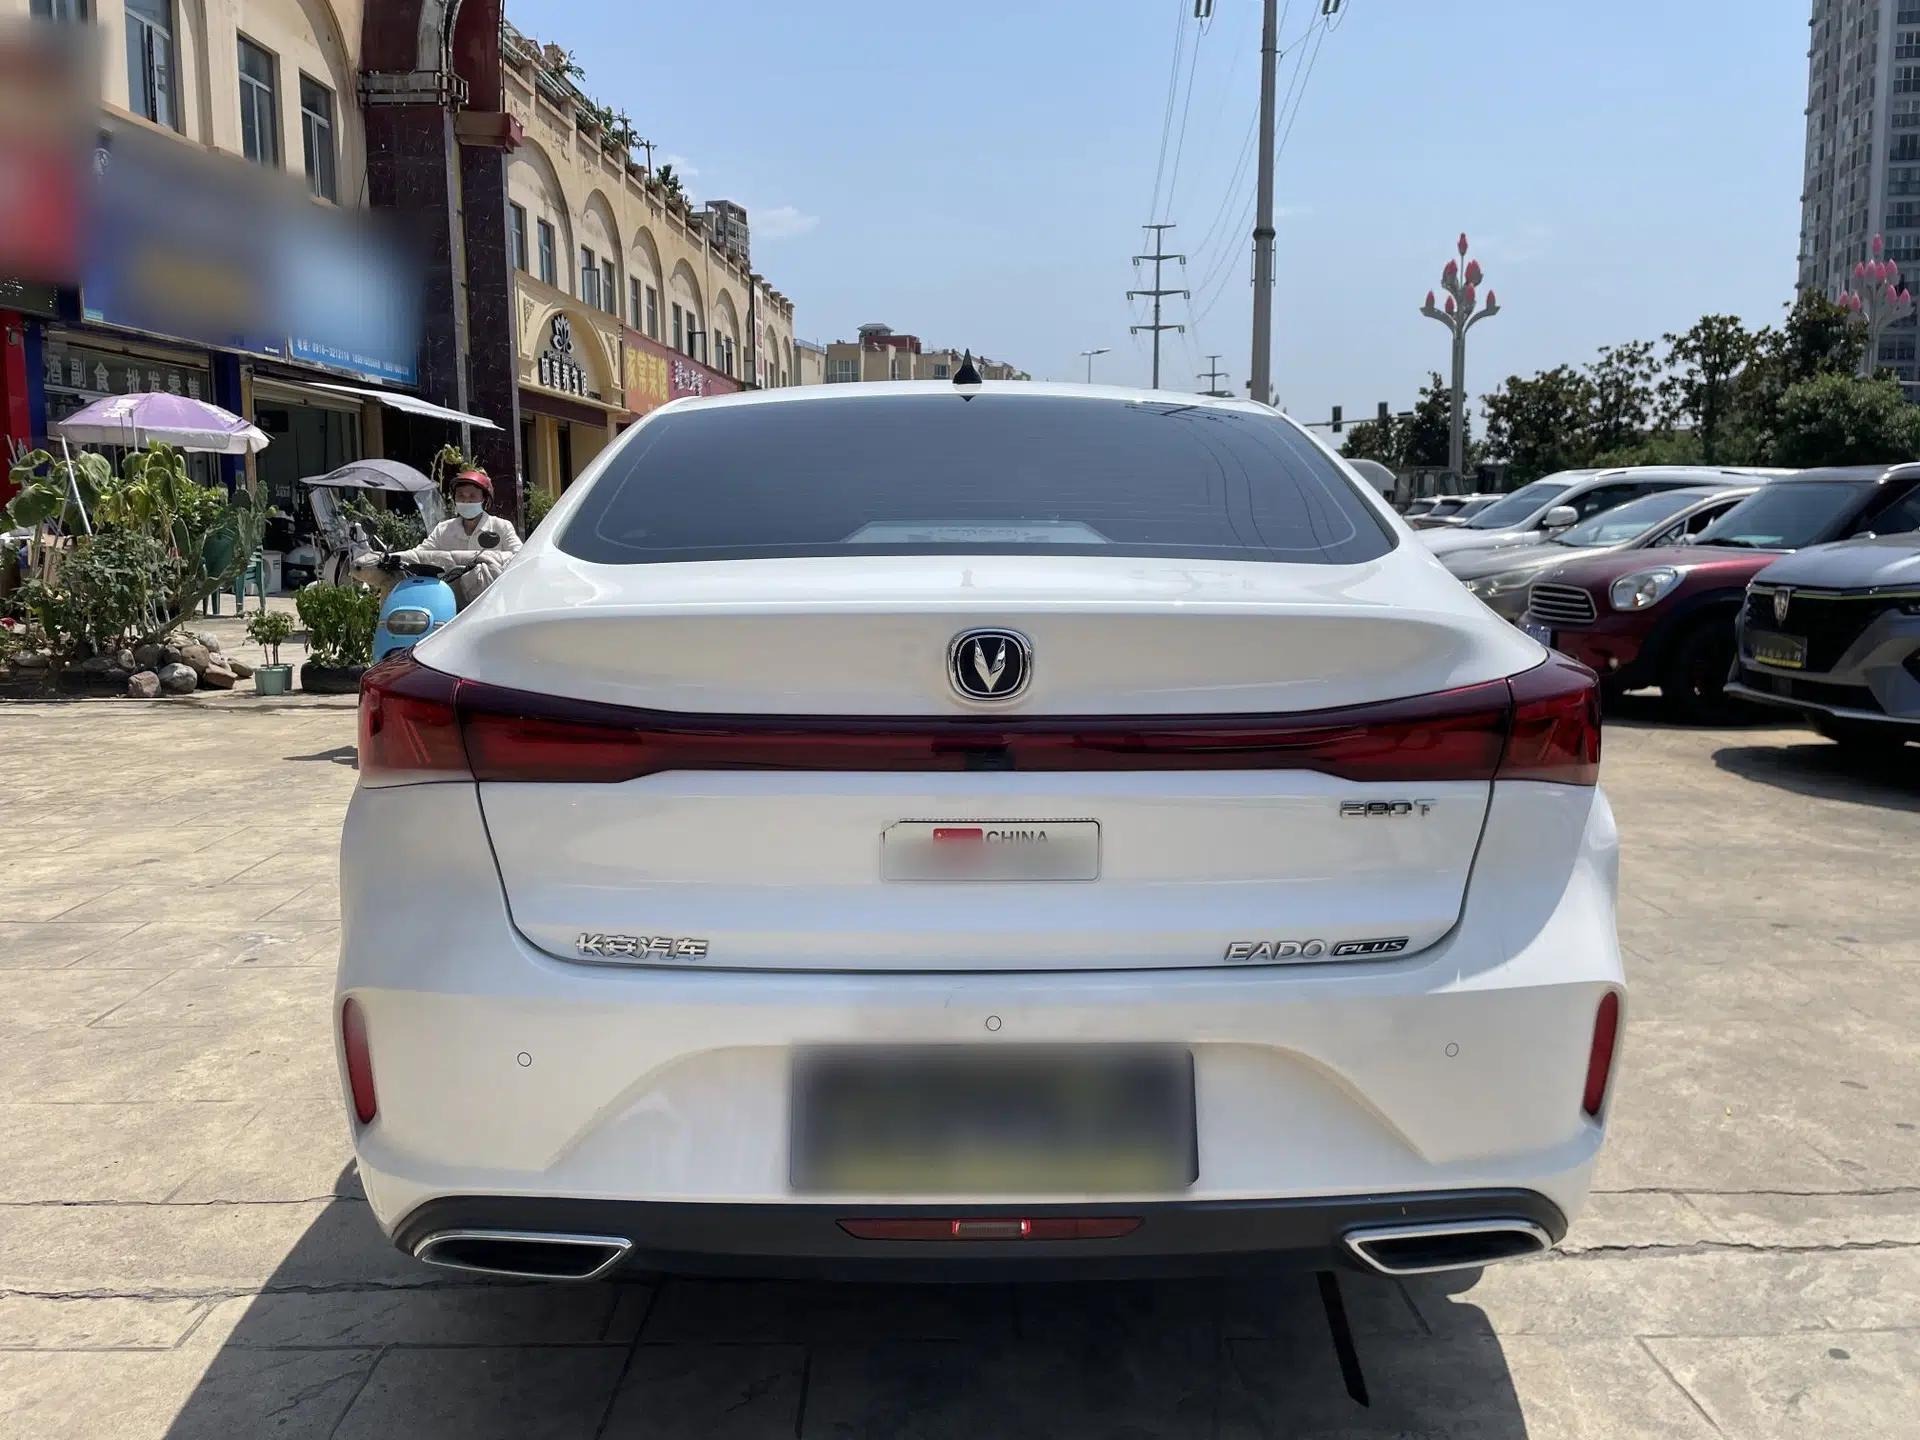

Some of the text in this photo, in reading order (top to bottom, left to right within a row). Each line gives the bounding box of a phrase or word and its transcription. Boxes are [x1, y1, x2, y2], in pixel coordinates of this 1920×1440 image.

[986, 830, 1048, 844] CHINA
[576, 933, 708, 960] 长安汽车
[1225, 939, 1405, 960] EADO PLUS
